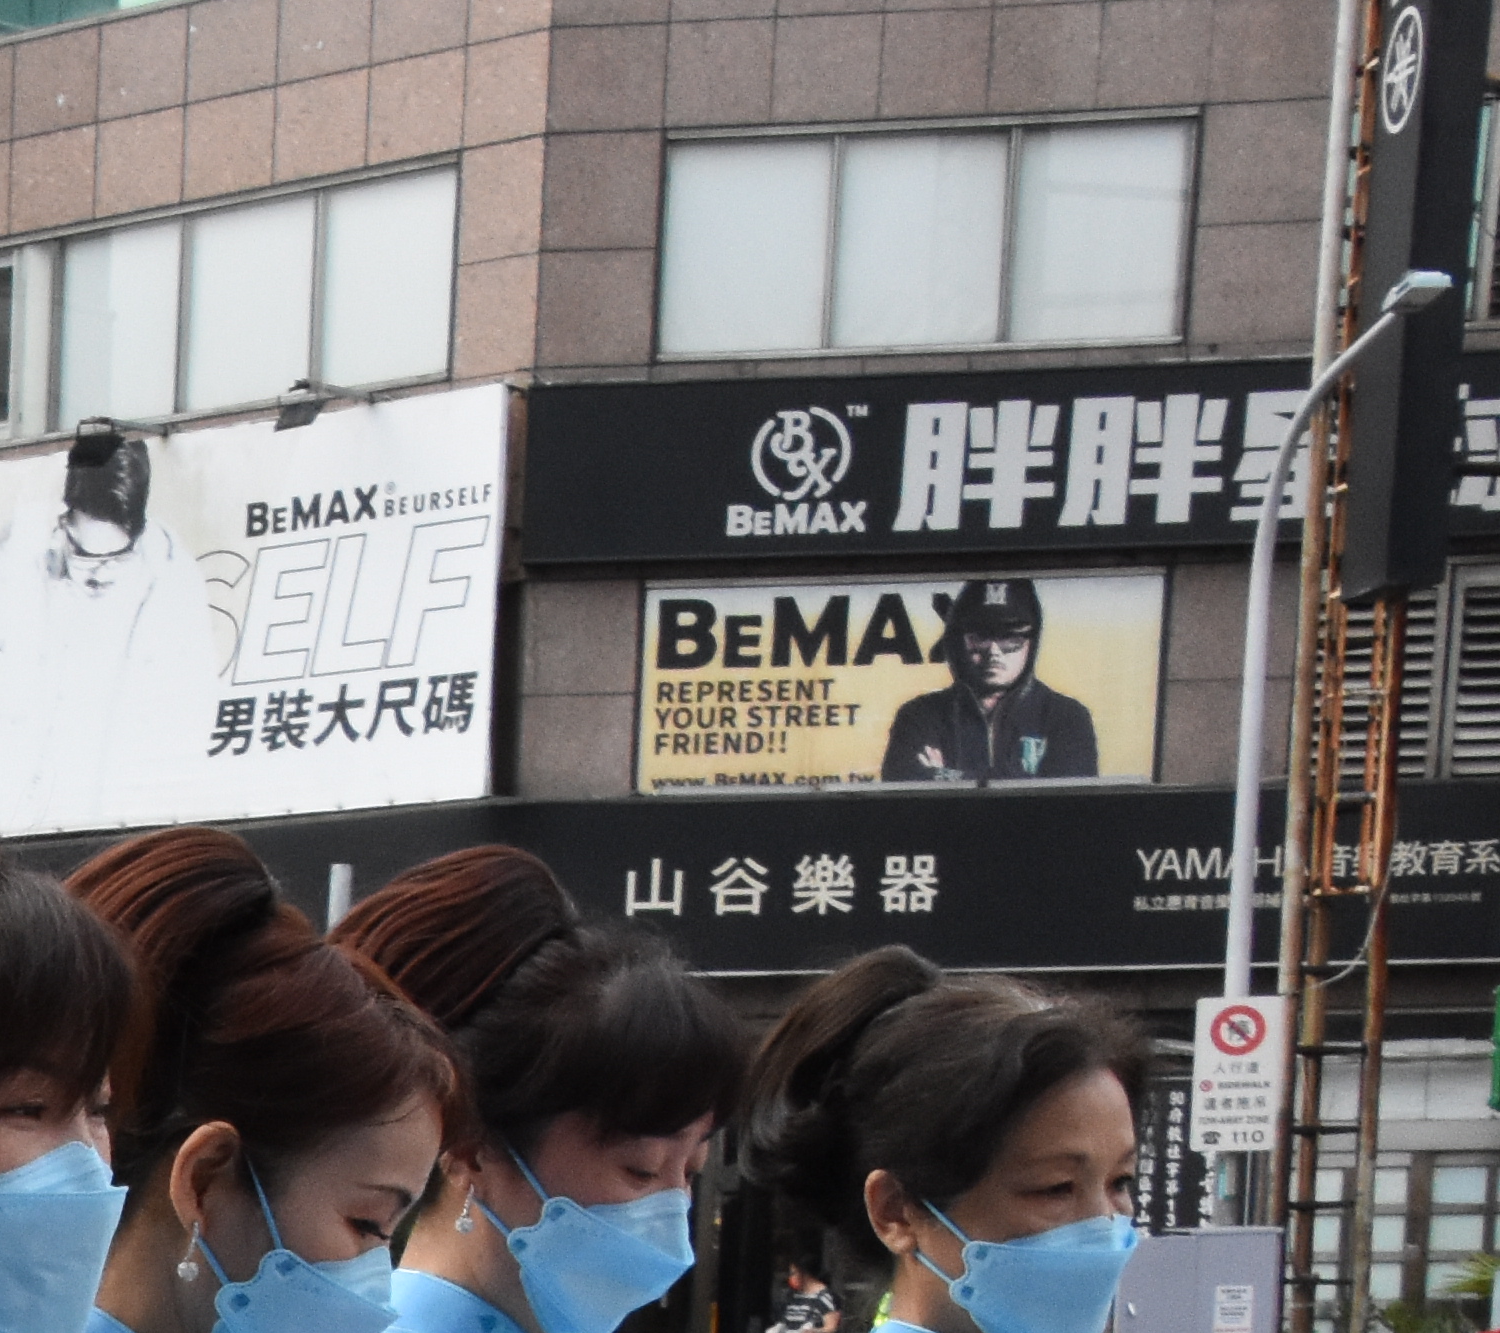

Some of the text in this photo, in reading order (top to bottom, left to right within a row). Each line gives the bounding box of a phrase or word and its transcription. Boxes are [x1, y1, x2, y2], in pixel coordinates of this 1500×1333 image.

[384, 483, 491, 518] BEURSELF
[656, 678, 836, 706] REPRESENT
[207, 671, 479, 758] 男裝大尺碼
[654, 703, 860, 730] YOUR STREET
[652, 730, 790, 757] FRIEND!!
[625, 852, 942, 917] 山谷樂器
[1233, 1129, 1265, 1145] 110
